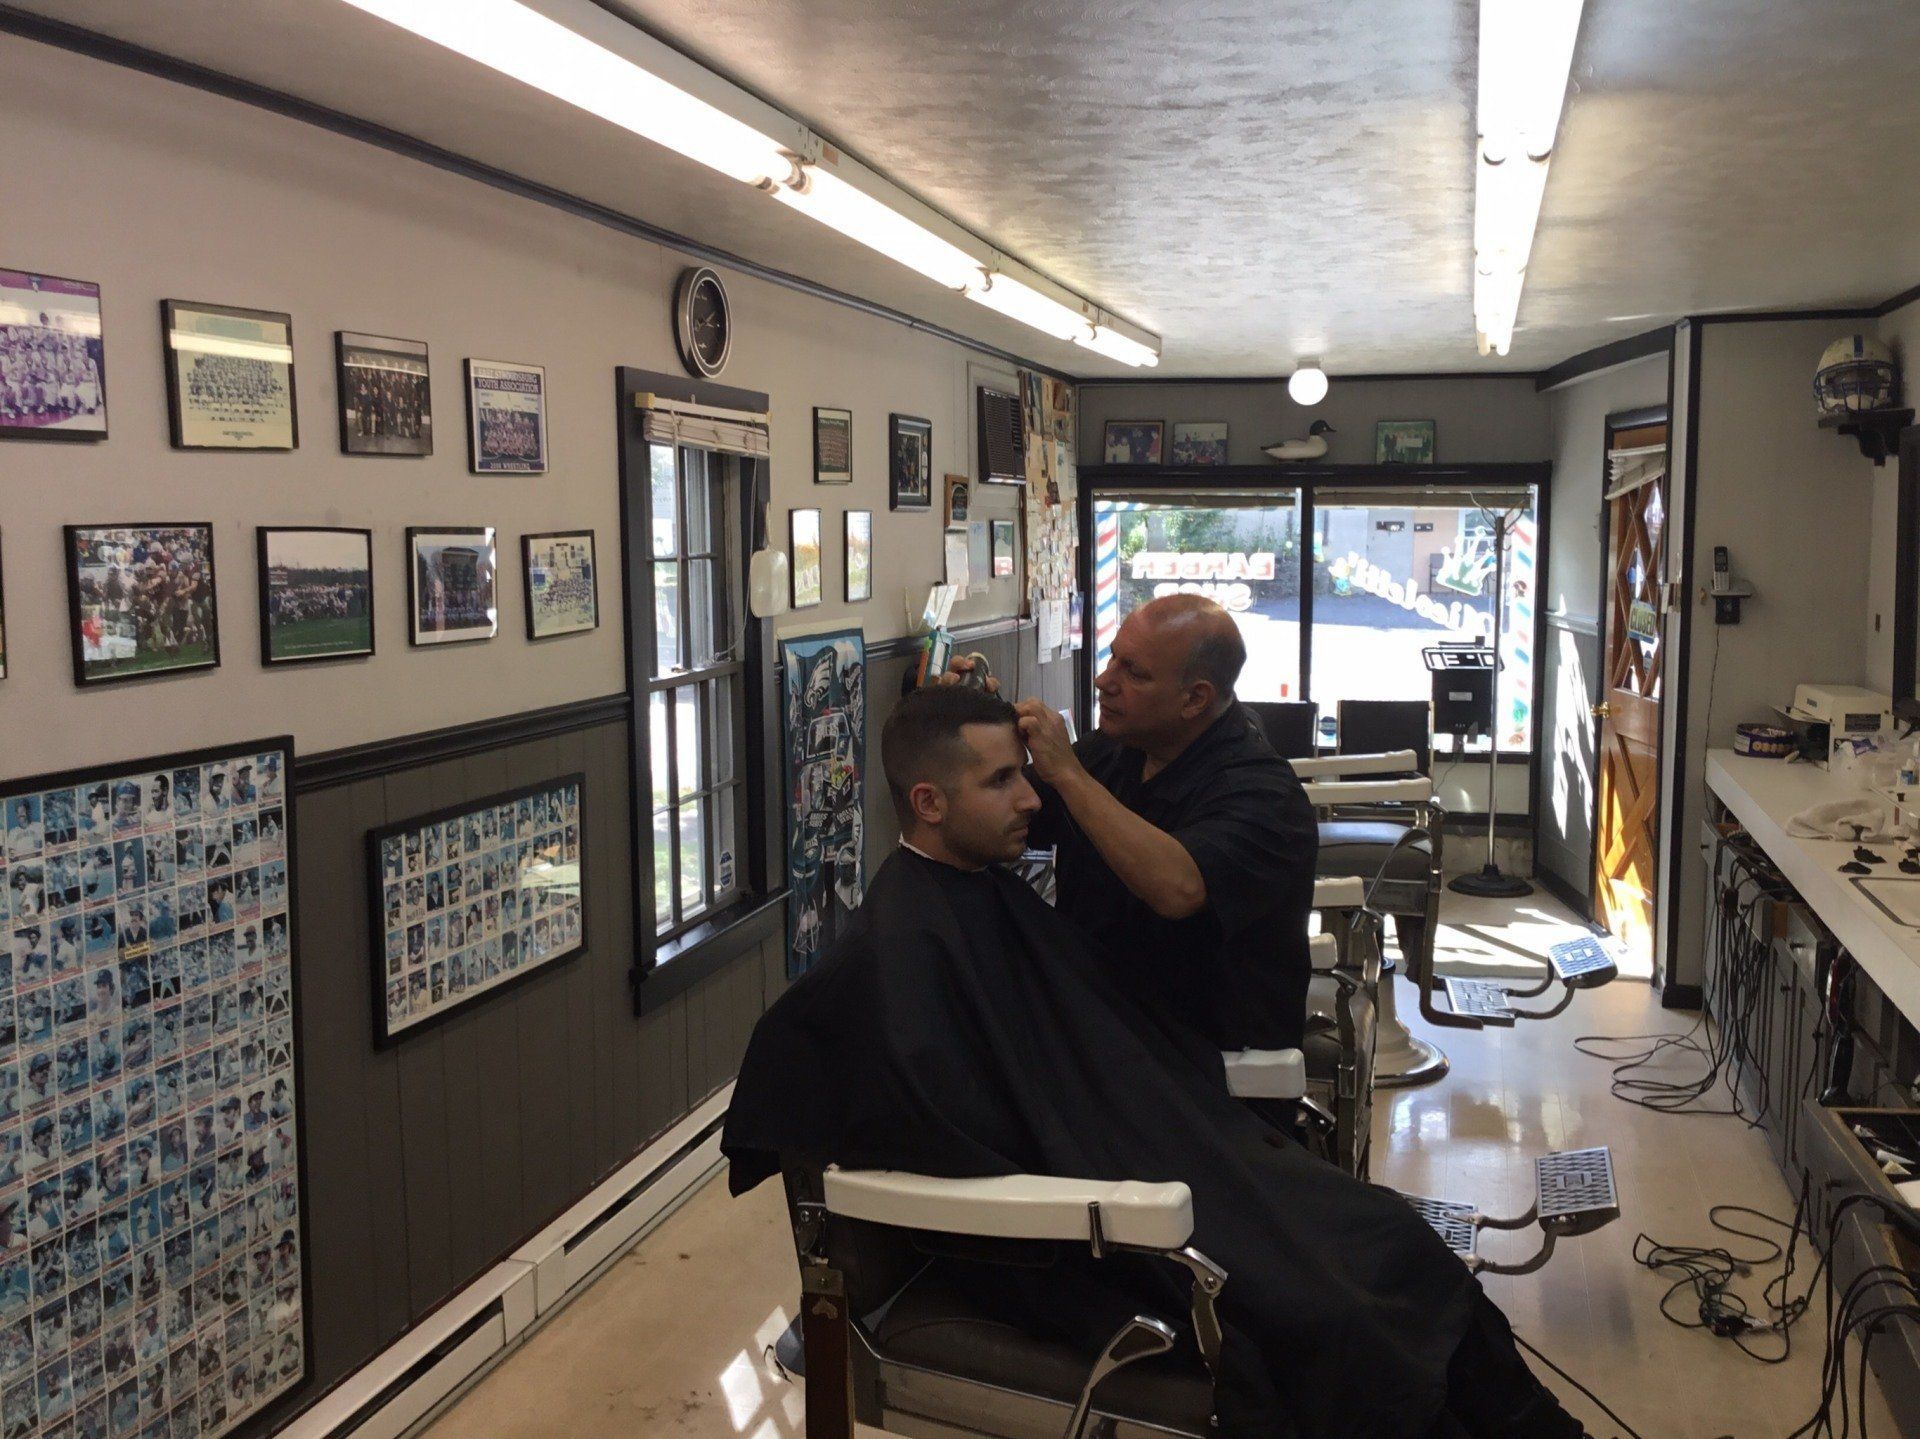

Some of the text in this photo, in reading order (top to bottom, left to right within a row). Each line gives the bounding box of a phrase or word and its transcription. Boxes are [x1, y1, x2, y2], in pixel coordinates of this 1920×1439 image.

[477, 378, 539, 393] YOUTH ASSOCIATION
[1631, 607, 1655, 637] CLOSED
